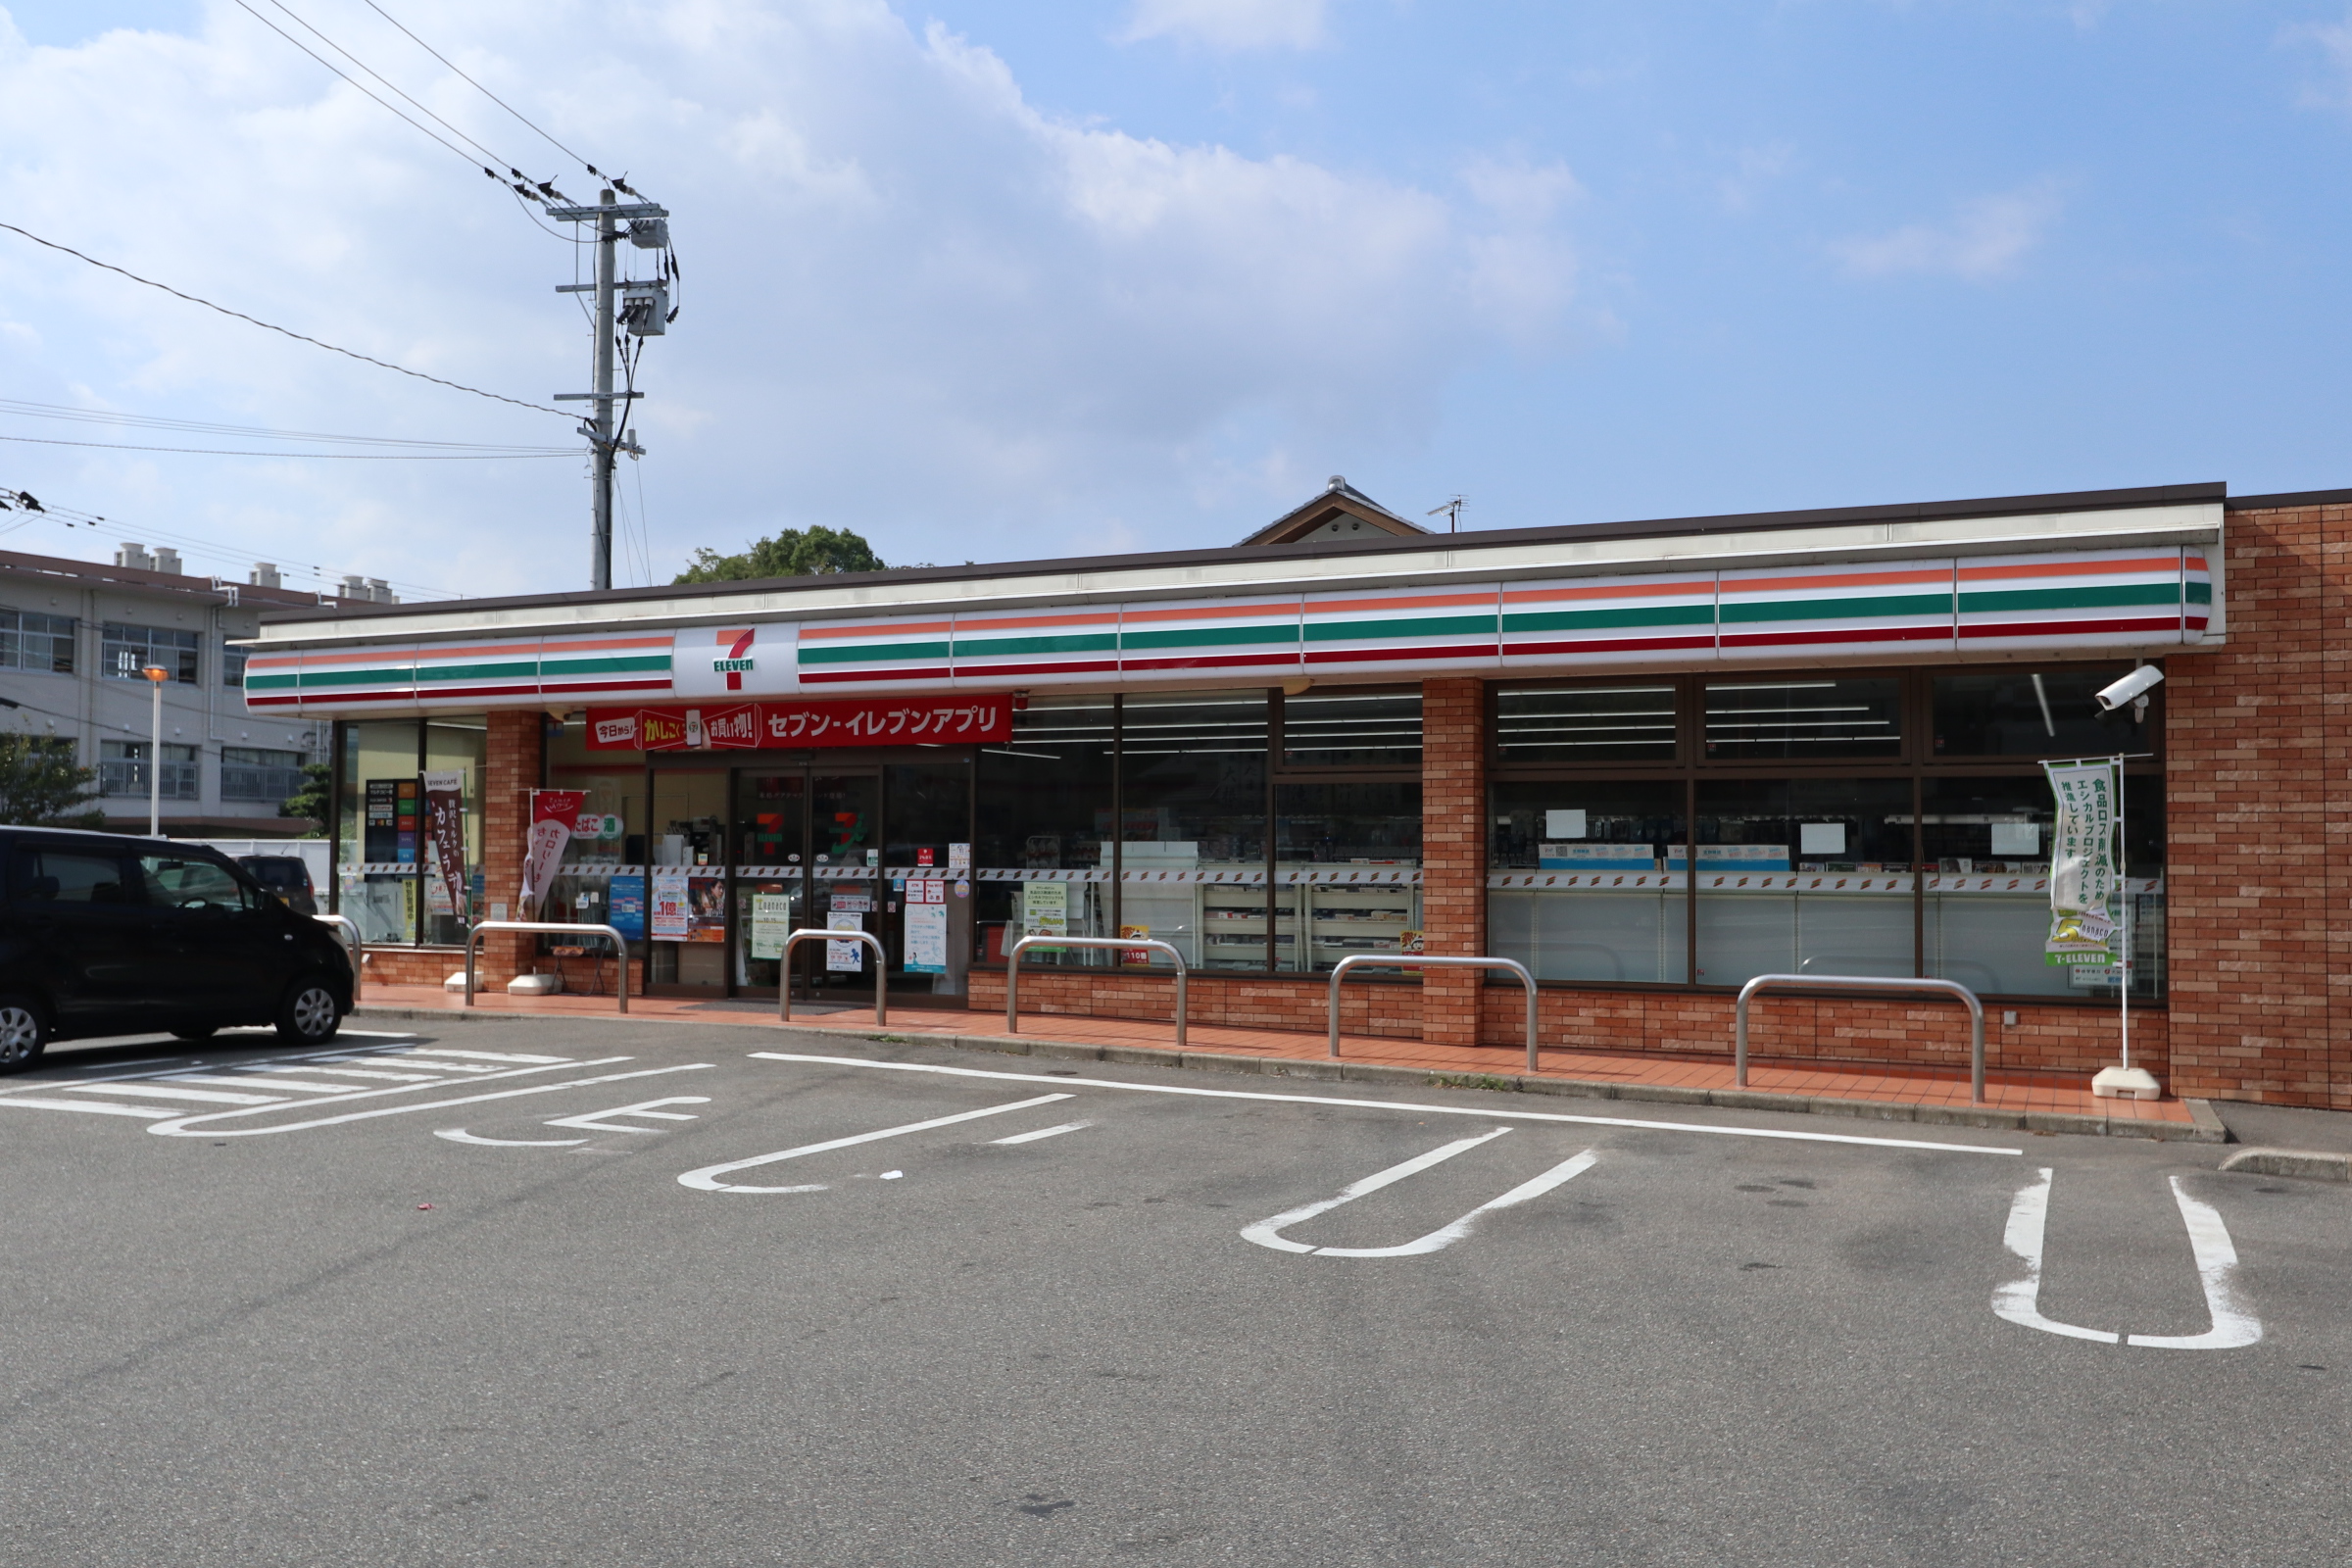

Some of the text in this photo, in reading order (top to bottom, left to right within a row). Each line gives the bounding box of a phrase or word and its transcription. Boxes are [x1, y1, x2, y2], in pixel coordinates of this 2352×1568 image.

[713, 660, 754, 672] ELEVEN
[599, 724, 633, 739] 今日から!
[645, 718, 680, 743] かしこく
[710, 711, 753, 739] お買い物!
[767, 706, 997, 737] セブン-イレブンアプリ
[434, 807, 461, 889] カフェラテ
[2078, 779, 2094, 905] エシカルプロジェクトを
[2092, 778, 2109, 901] 食品ロス削減のため
[2082, 924, 2109, 937] nanaco
[2054, 954, 2105, 964] 7-ELEVEN
